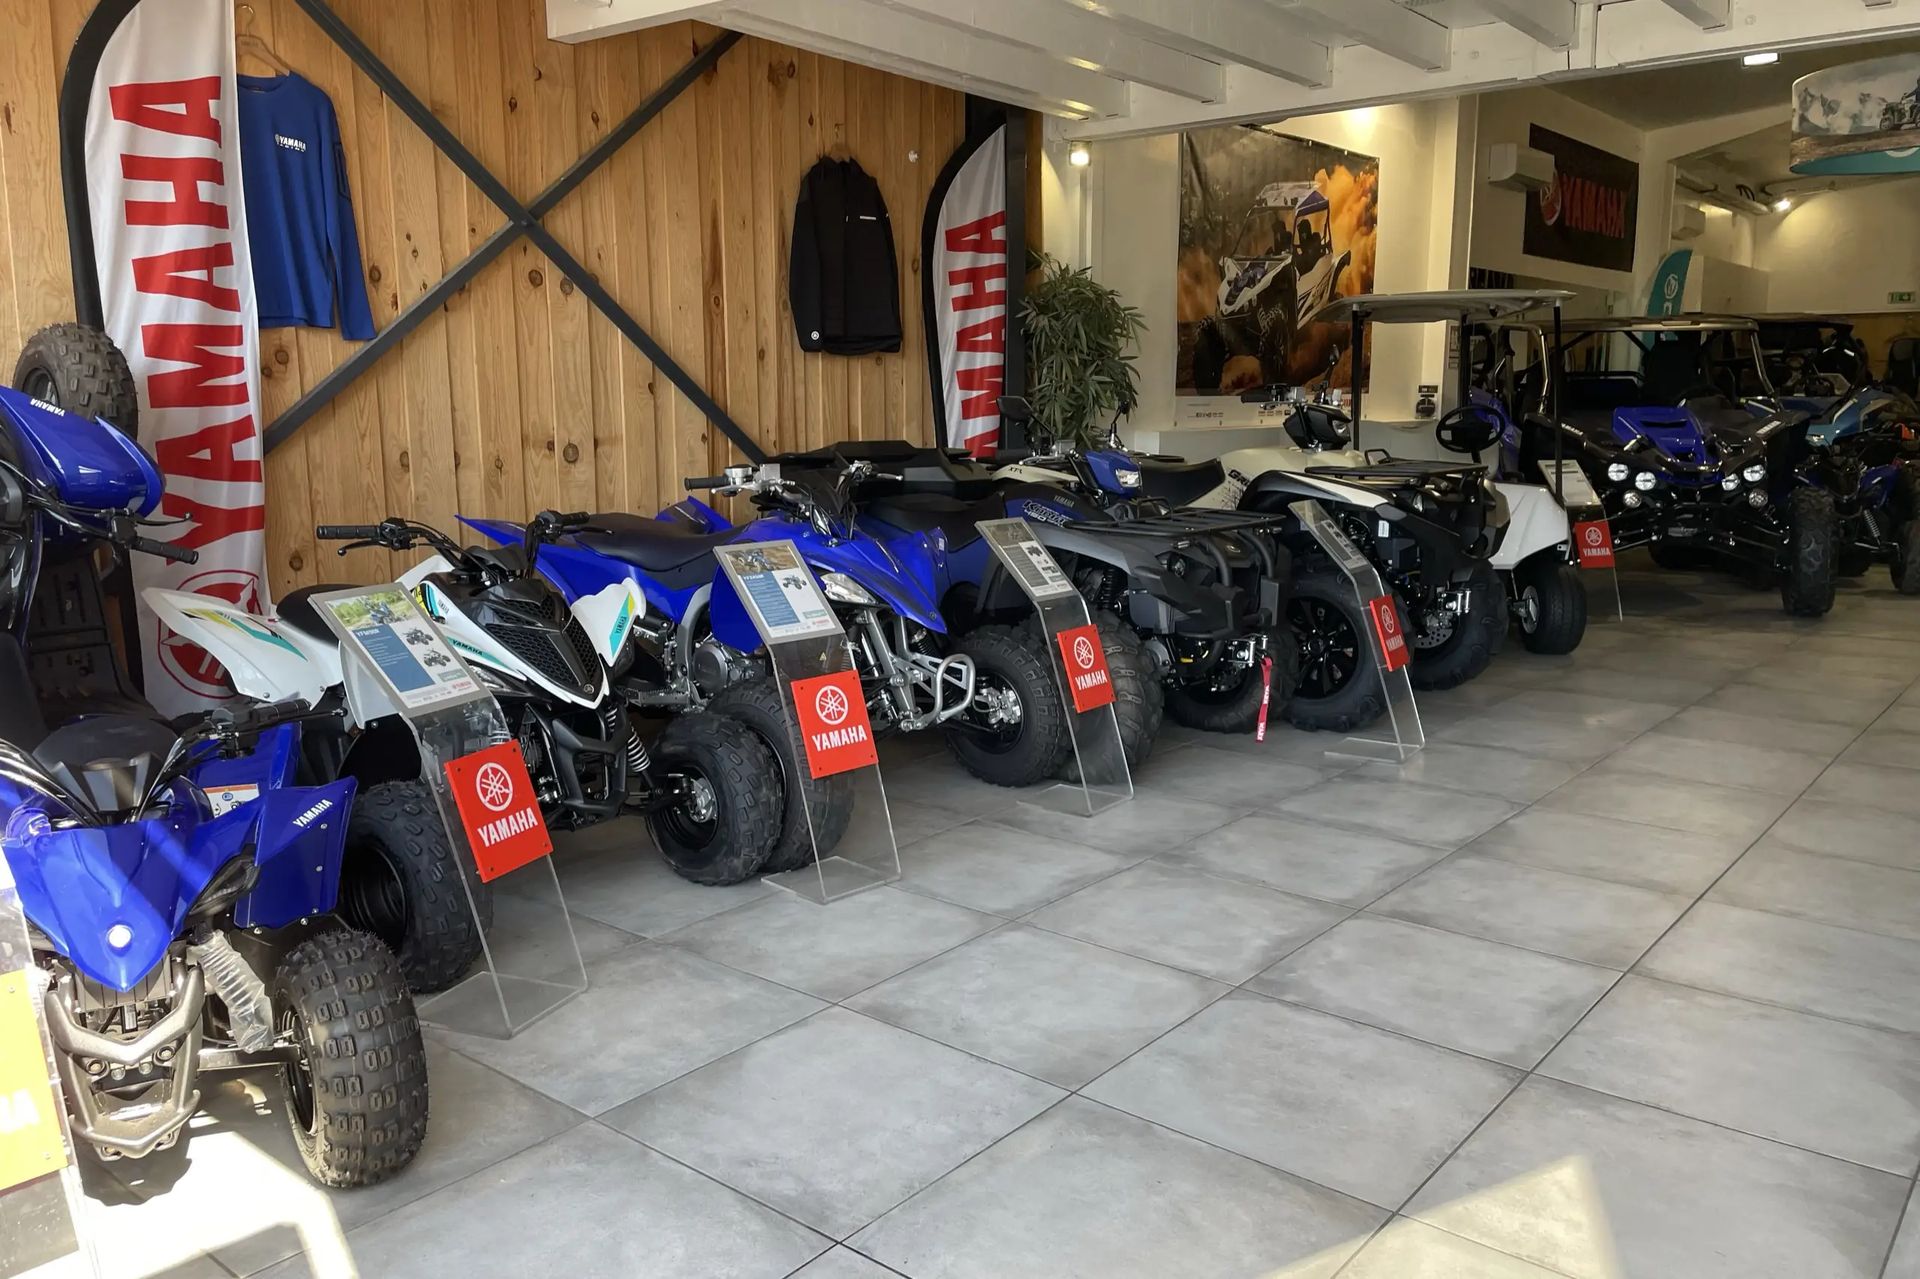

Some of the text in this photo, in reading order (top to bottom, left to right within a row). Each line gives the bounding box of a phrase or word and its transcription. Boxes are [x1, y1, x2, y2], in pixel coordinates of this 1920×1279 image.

[279, 135, 306, 151] YAMAHA
[1560, 172, 1627, 239] YAMAHA
[109, 75, 265, 566] YAMAHA
[944, 209, 1007, 460] AMAHA
[30, 398, 66, 417] YAMAHA
[1583, 547, 1611, 556] YAMAHA
[452, 639, 483, 656] YAMAHA
[1075, 669, 1107, 691] YAMAHA
[811, 724, 868, 752] YAMAHA
[292, 799, 333, 828] YAMAHA
[477, 807, 539, 848] YAMAHA
